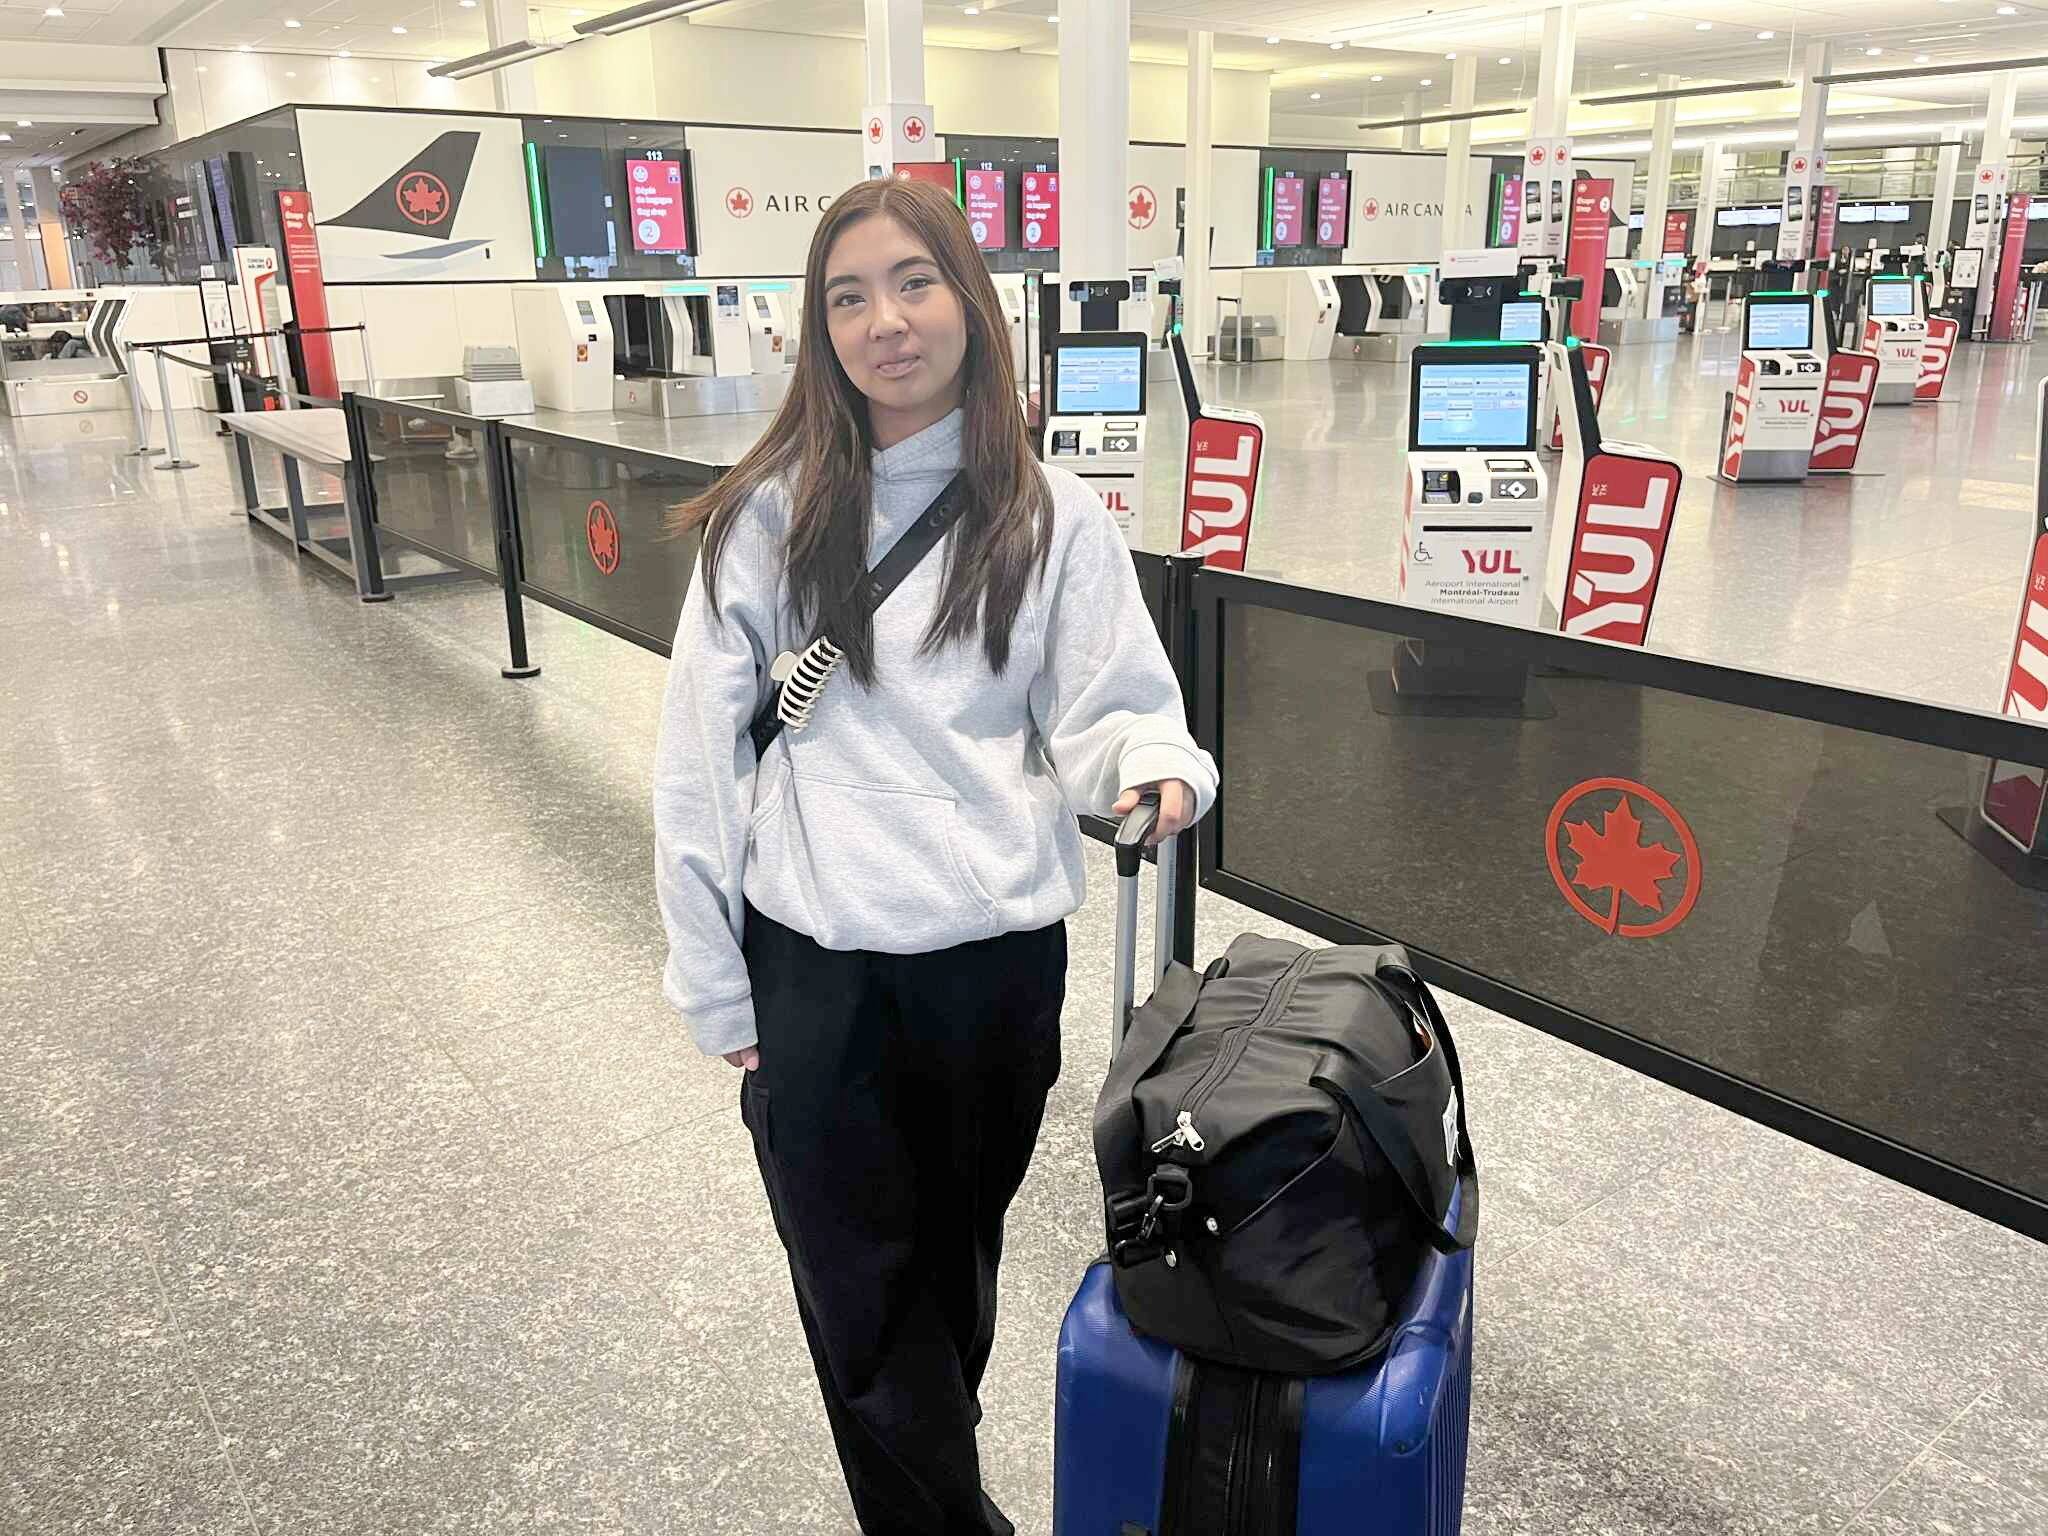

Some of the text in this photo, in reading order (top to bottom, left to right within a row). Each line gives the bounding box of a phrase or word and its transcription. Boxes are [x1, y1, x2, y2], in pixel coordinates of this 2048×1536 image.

[646, 150, 664, 160] 113
[980, 162, 993, 170] 112
[766, 195, 809, 212] AIR
[1385, 203, 1472, 216] AIR CANA
[1779, 400, 1811, 413] YUL
[1813, 365, 1873, 457] YUL
[1183, 436, 1254, 555] YUL
[1461, 549, 1522, 574] YUL
[1567, 477, 1669, 635] YUL
[1425, 579, 1464, 590] Aéroport
[1440, 588, 1520, 597] Montréal-Trudeau
[1488, 597, 1519, 608] Airport
